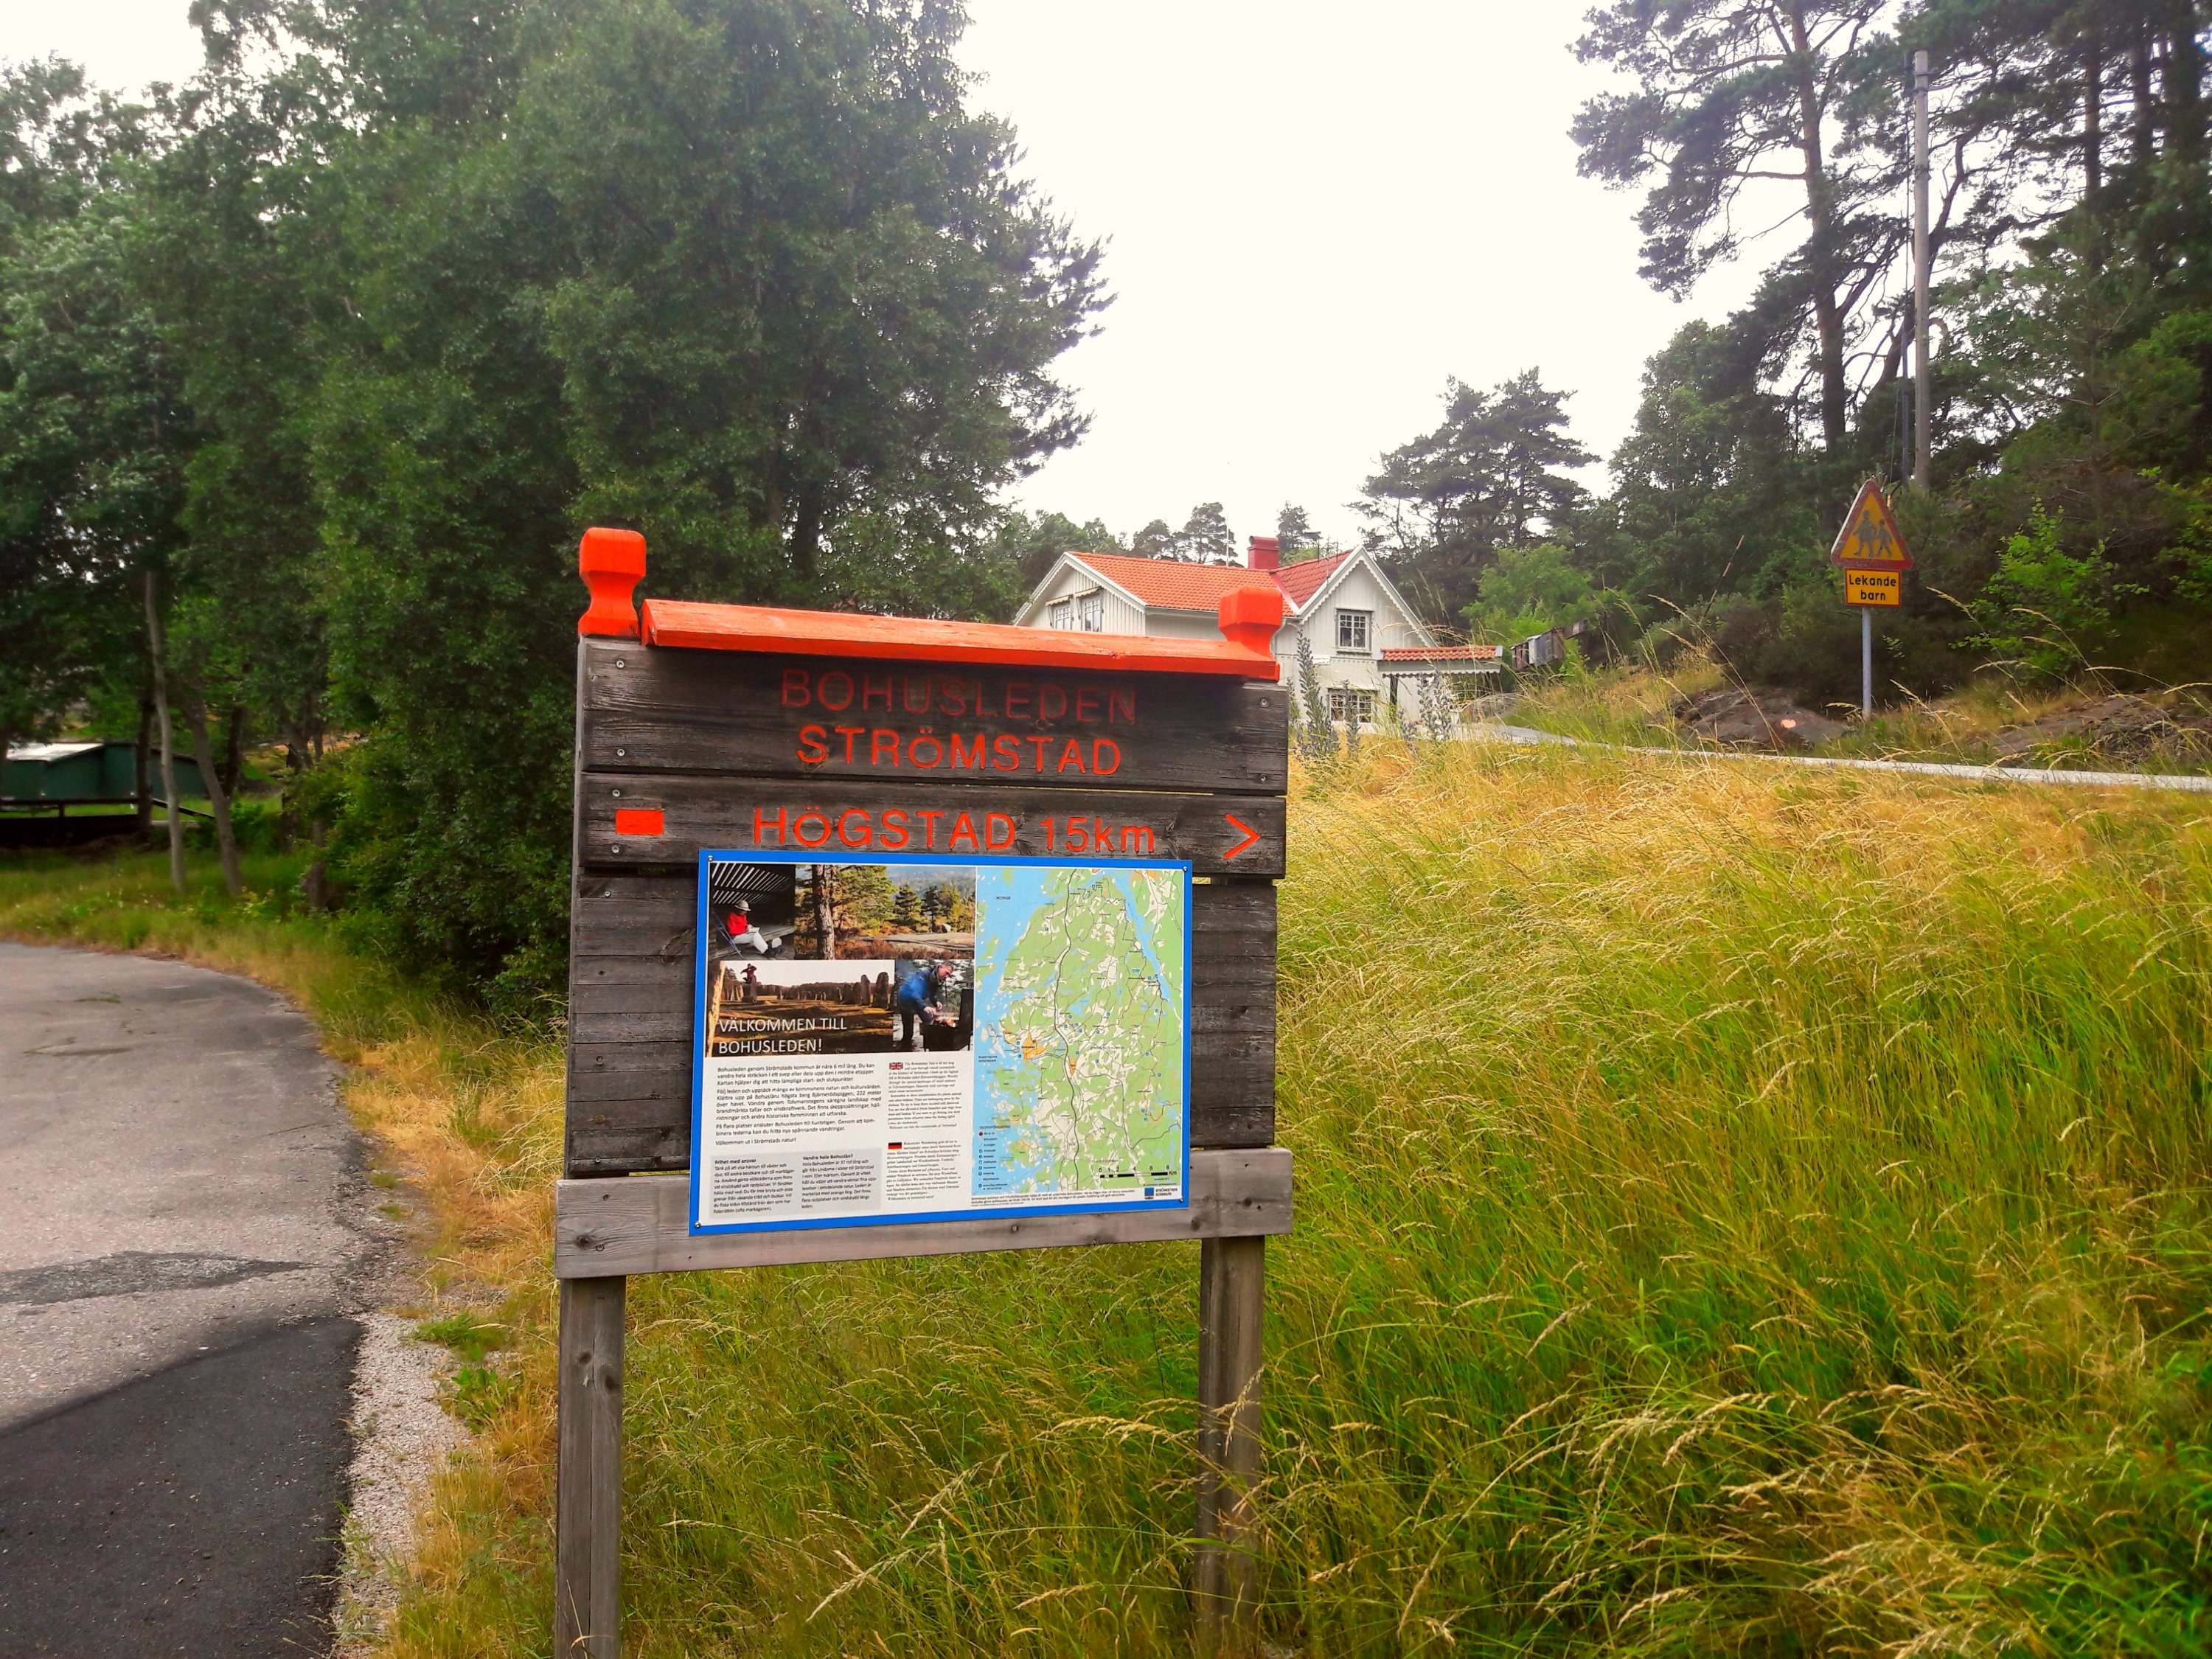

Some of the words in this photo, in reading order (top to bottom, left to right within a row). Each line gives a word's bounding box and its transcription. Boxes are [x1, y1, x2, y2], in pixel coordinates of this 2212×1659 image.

[1849, 574, 1897, 587] Lekande
[1860, 589, 1886, 601] barn
[781, 669, 1135, 725] BOHUSLEDEN
[797, 725, 1121, 775] STRÖMSTAD
[754, 805, 1015, 849] HÖGSTAD
[1040, 816, 1155, 853] 15km
[719, 1017, 815, 1032] VÄLKOMMEN
[820, 1018, 847, 1030] TILL
[719, 1039, 822, 1054] BOHUSLEDEN!
